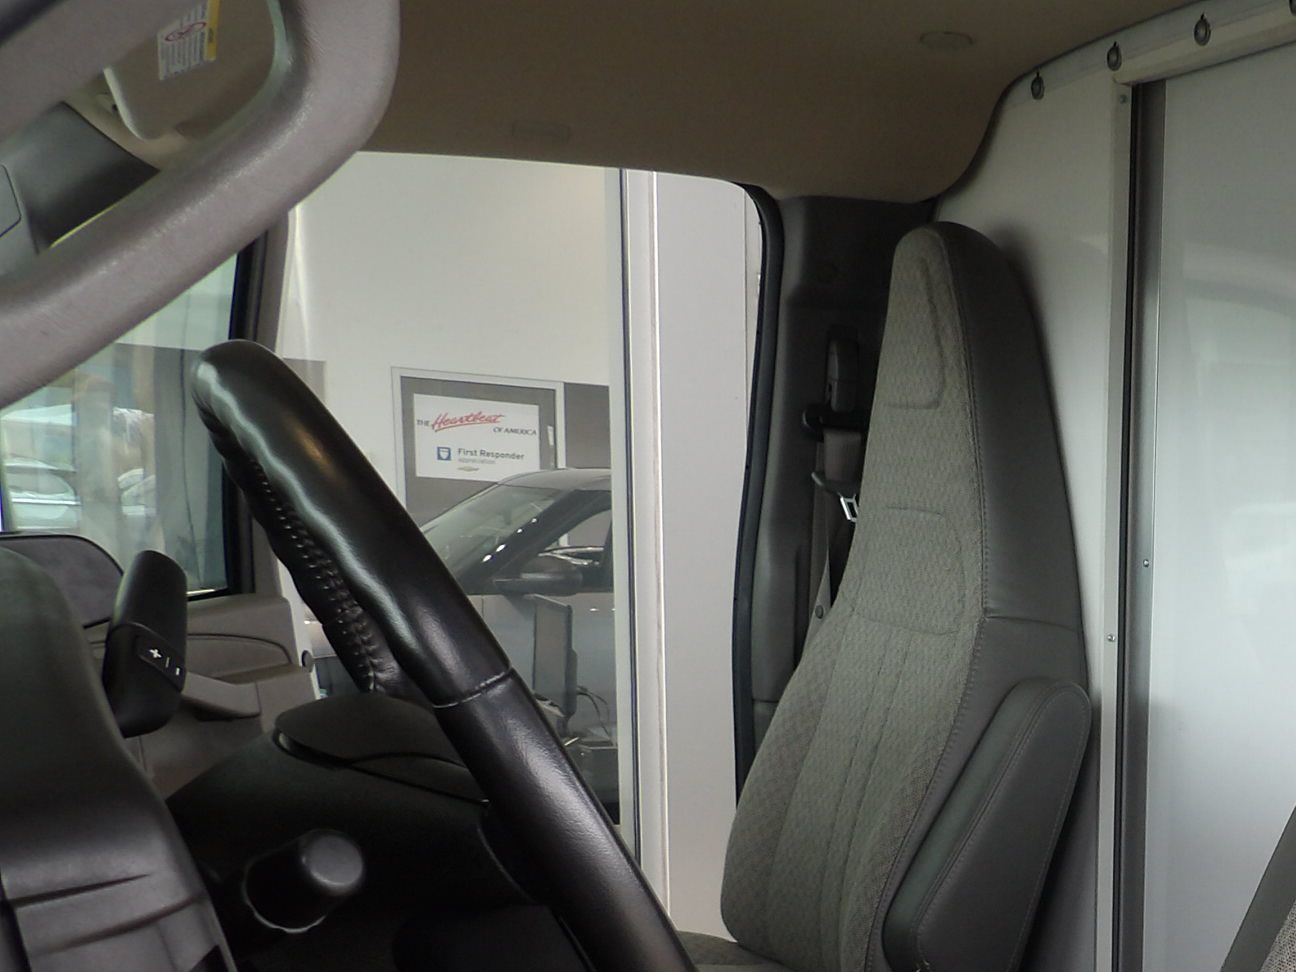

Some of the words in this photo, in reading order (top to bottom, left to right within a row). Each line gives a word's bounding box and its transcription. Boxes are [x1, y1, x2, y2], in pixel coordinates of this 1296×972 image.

[416, 419, 430, 427] THE
[431, 411, 505, 432] Heartbeat
[503, 427, 537, 436] AMERICA
[458, 448, 478, 457] First
[479, 449, 525, 461] Responder
